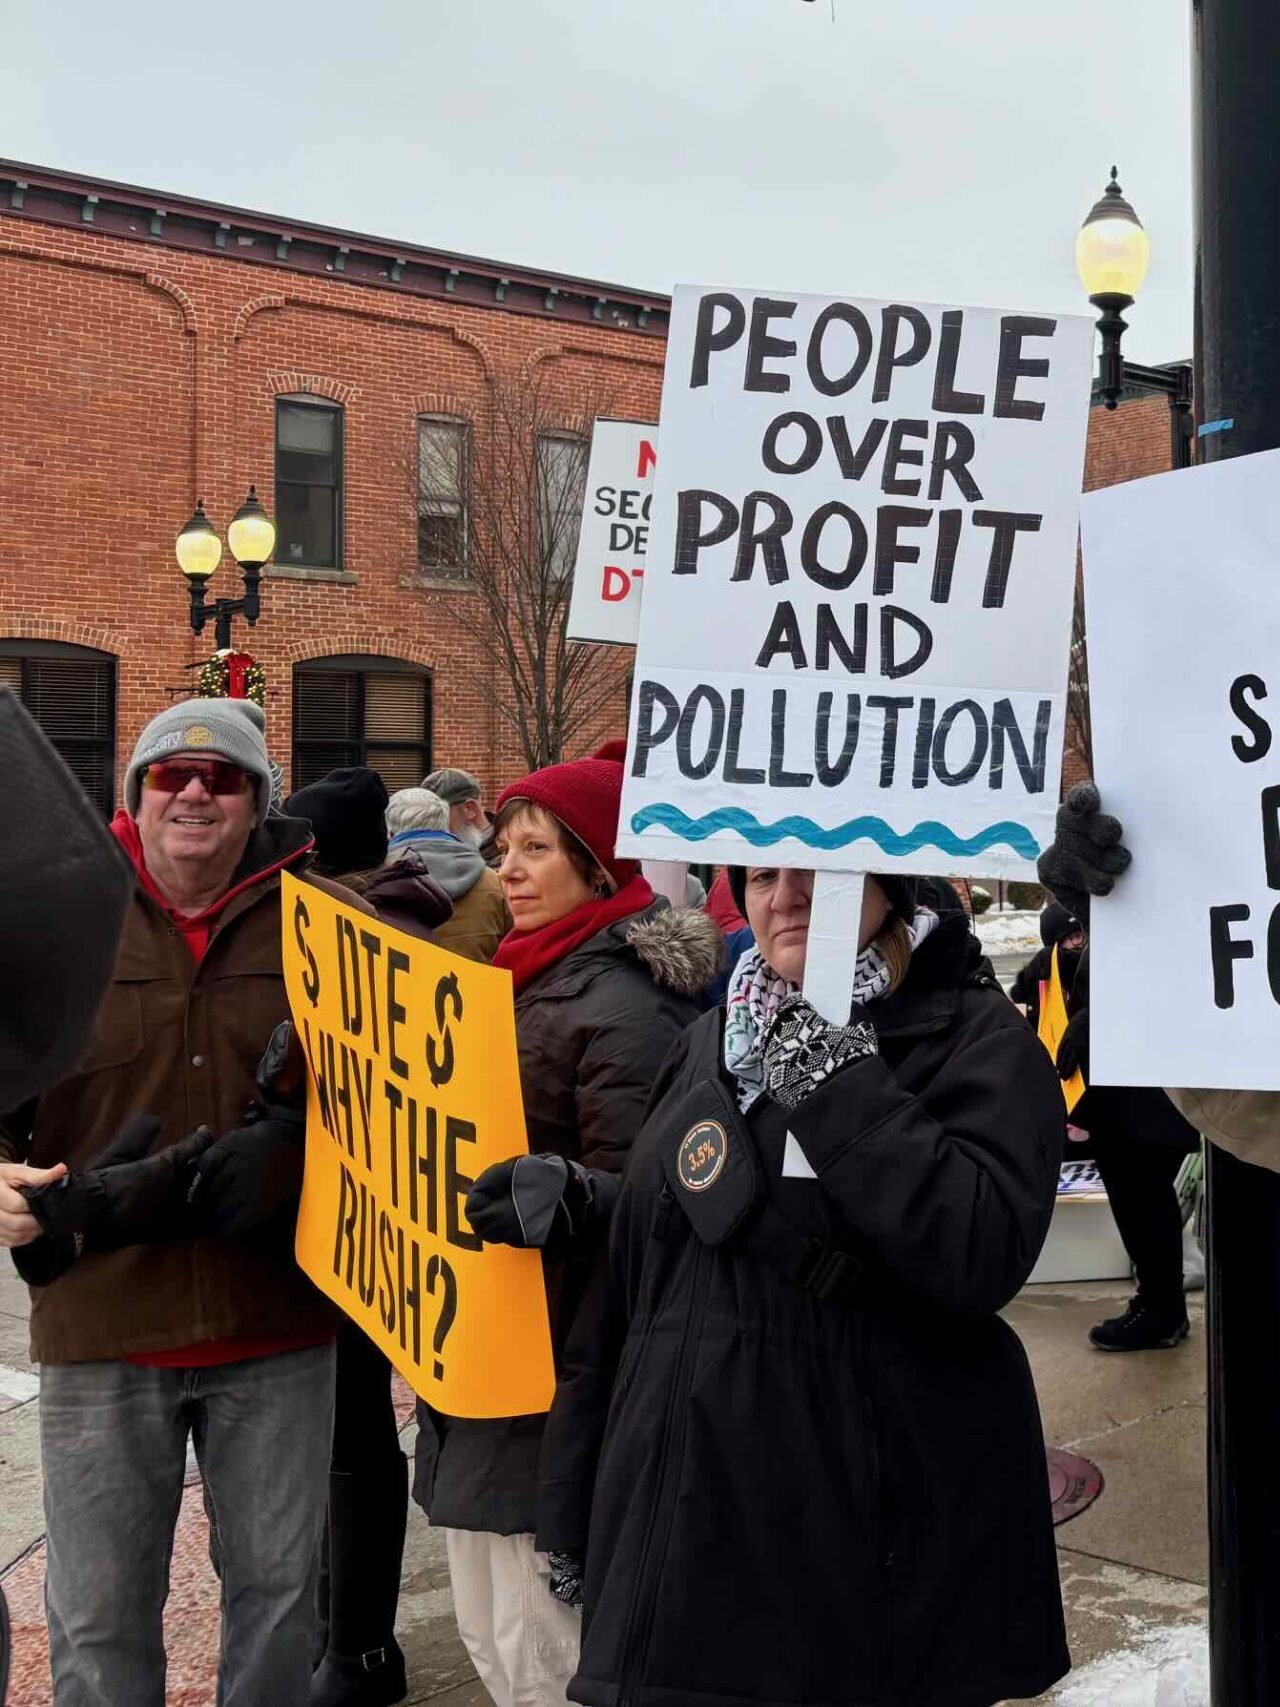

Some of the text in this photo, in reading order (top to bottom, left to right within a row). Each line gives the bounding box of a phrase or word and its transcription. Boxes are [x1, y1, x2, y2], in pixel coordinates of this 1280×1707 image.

[690, 292, 1057, 421] PEOPLE
[761, 411, 984, 502] OVER
[671, 490, 1043, 608] PROFIT
[755, 600, 933, 679] AND
[631, 680, 1051, 794] POLLUTION
[294, 894, 463, 1089] $ DTE $
[304, 1018, 485, 1253] WHY THE
[689, 1140, 715, 1171] 3.5%
[334, 1161, 458, 1383] RUSH?
